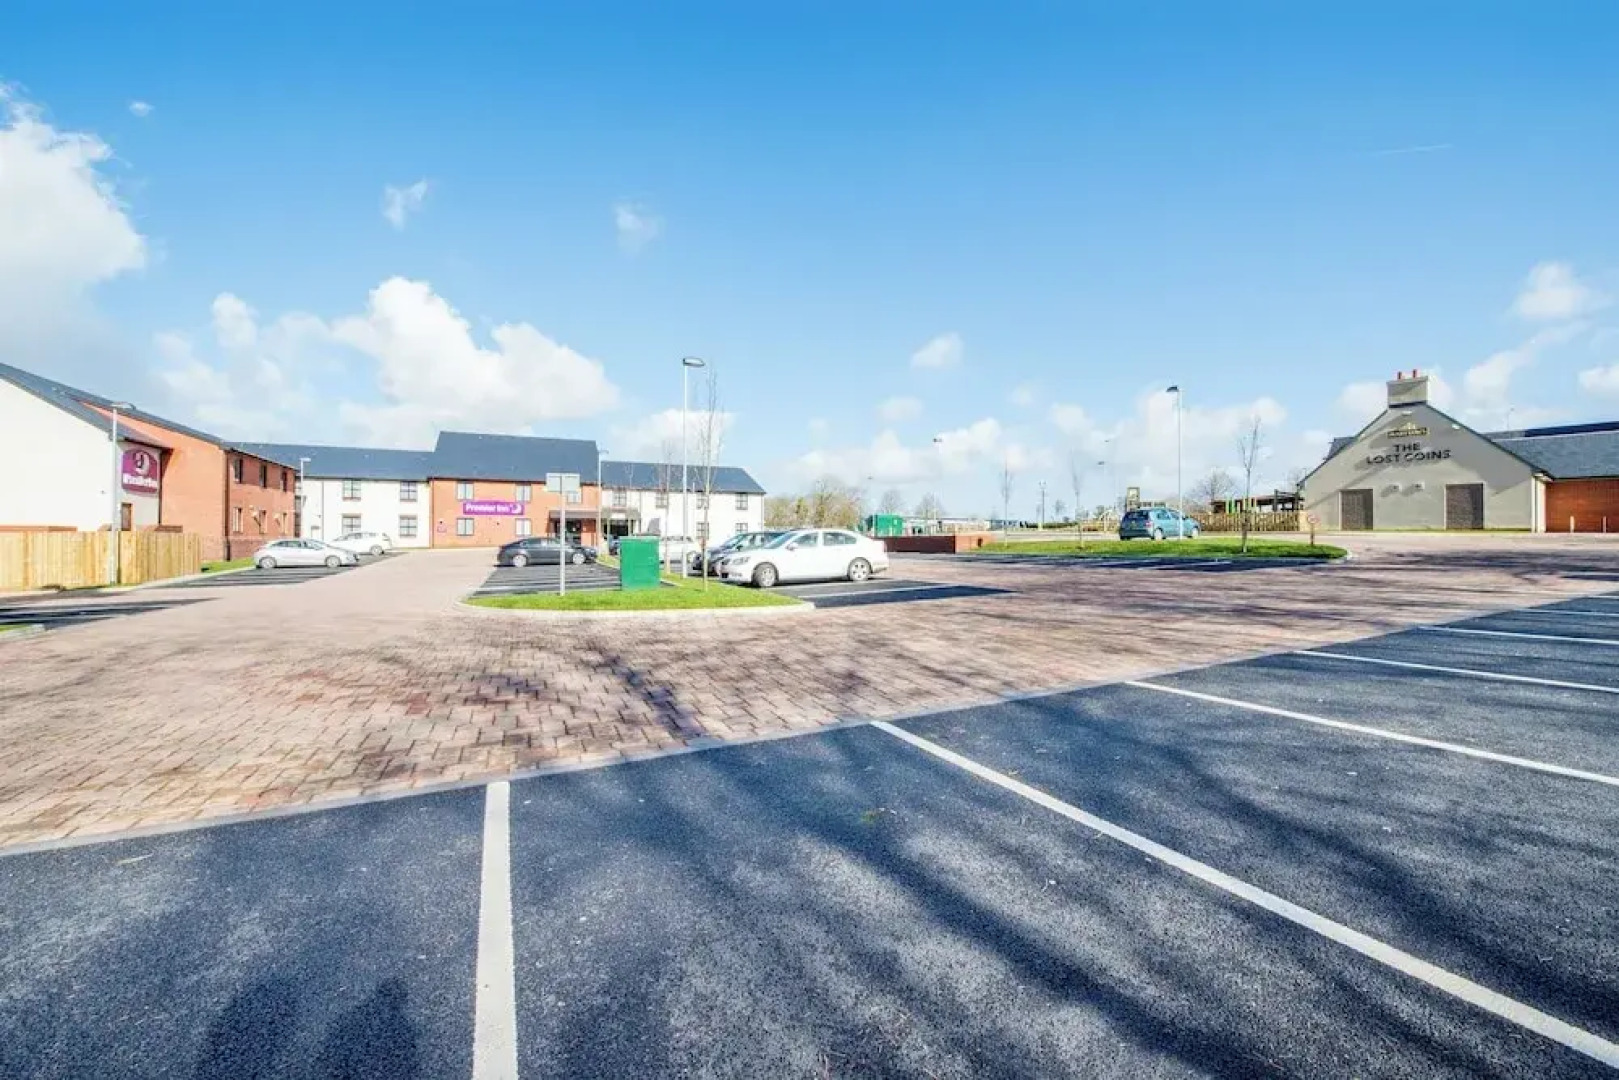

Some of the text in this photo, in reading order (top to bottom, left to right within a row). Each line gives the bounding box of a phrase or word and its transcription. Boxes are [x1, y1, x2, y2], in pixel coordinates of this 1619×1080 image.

[1393, 443, 1421, 452] THE
[1365, 449, 1452, 464] LOST COINS
